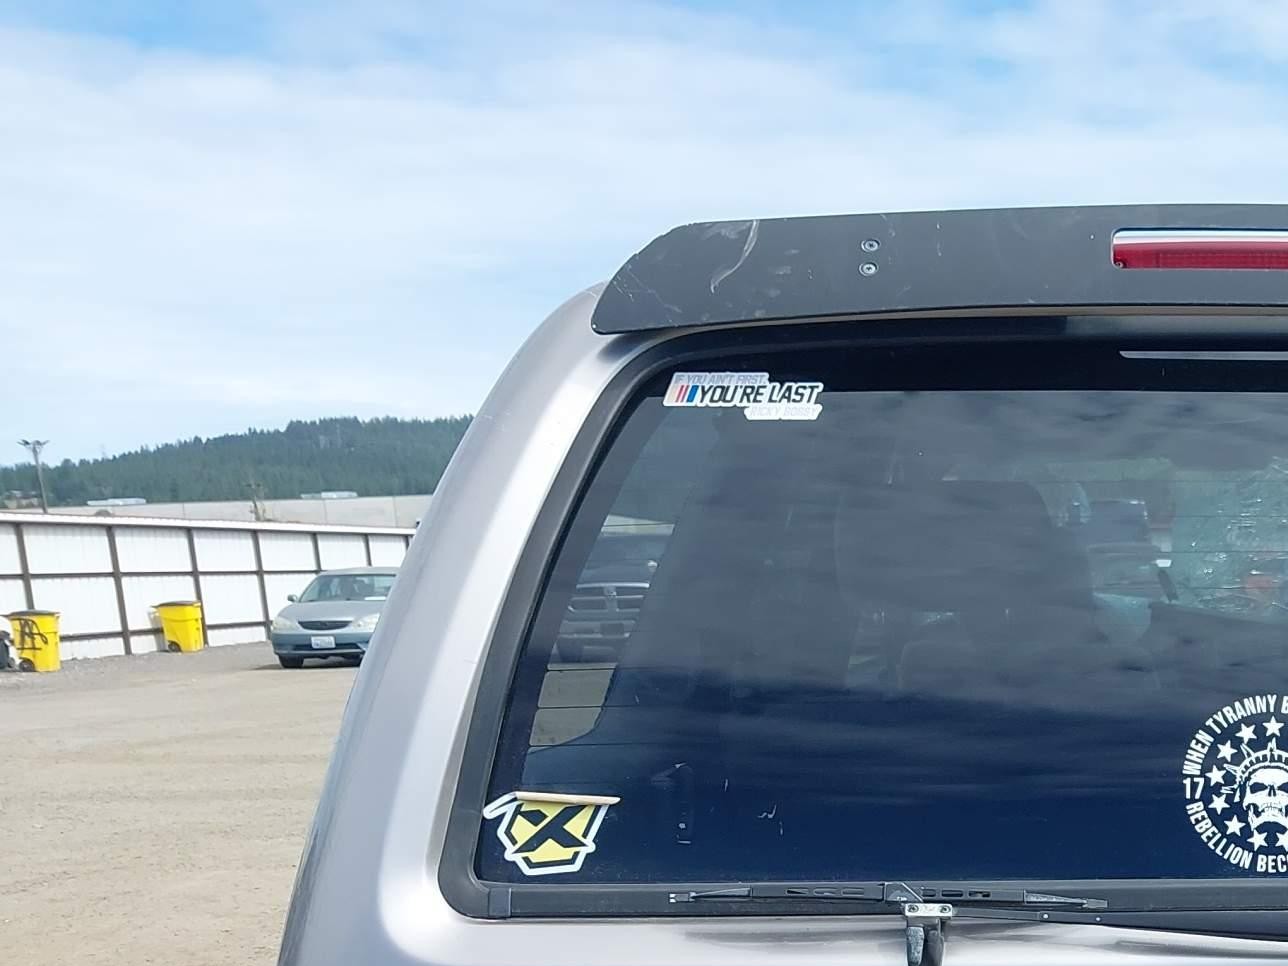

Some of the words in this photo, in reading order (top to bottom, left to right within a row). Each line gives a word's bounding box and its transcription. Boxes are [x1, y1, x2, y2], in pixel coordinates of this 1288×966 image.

[686, 374, 708, 385] YOU
[700, 384, 767, 404] YOU'RE
[768, 384, 821, 404] LAST
[1182, 729, 1214, 776] WHEN
[1205, 694, 1278, 734] TYRANNY
[1183, 777, 1205, 800] 17
[1186, 801, 1253, 869] REBELLION
